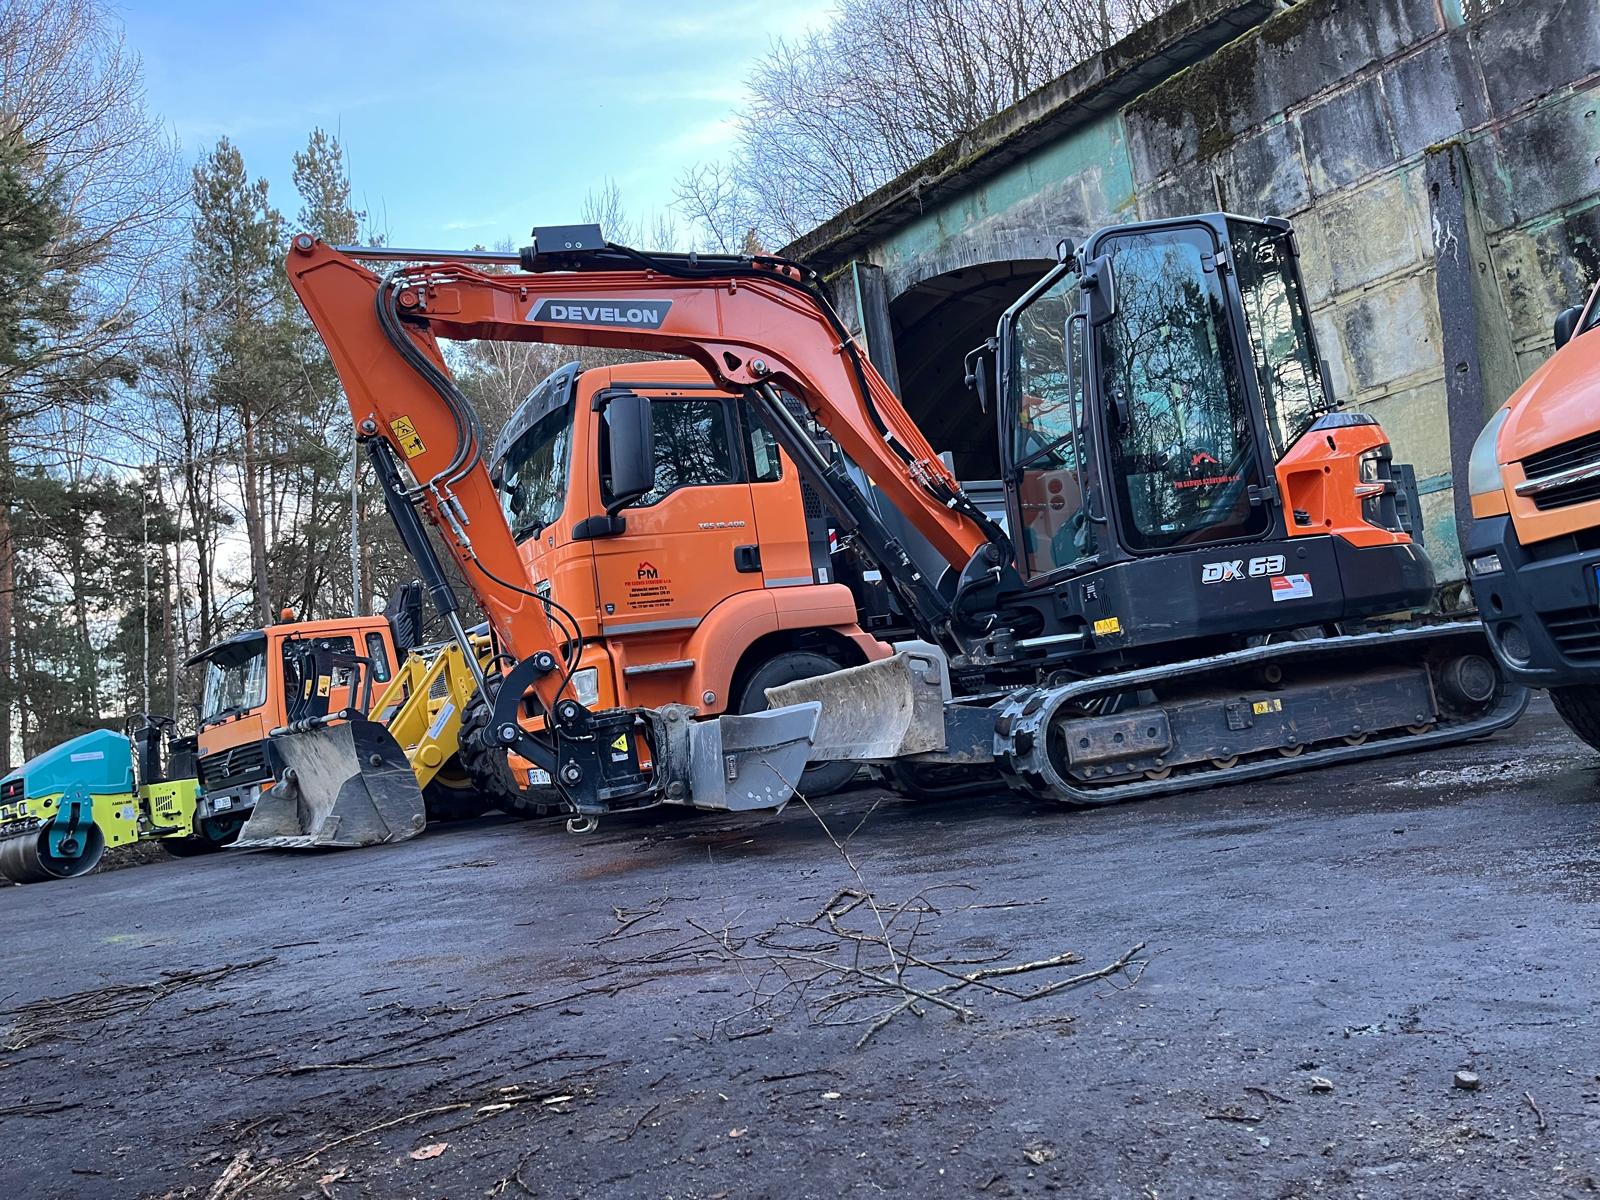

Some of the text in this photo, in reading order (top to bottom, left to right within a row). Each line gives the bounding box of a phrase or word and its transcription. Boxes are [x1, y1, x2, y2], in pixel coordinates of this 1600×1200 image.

[550, 305, 658, 323] DEVELON
[637, 568, 658, 580] PM
[1201, 559, 1246, 584] DX
[1248, 554, 1286, 578] 63
